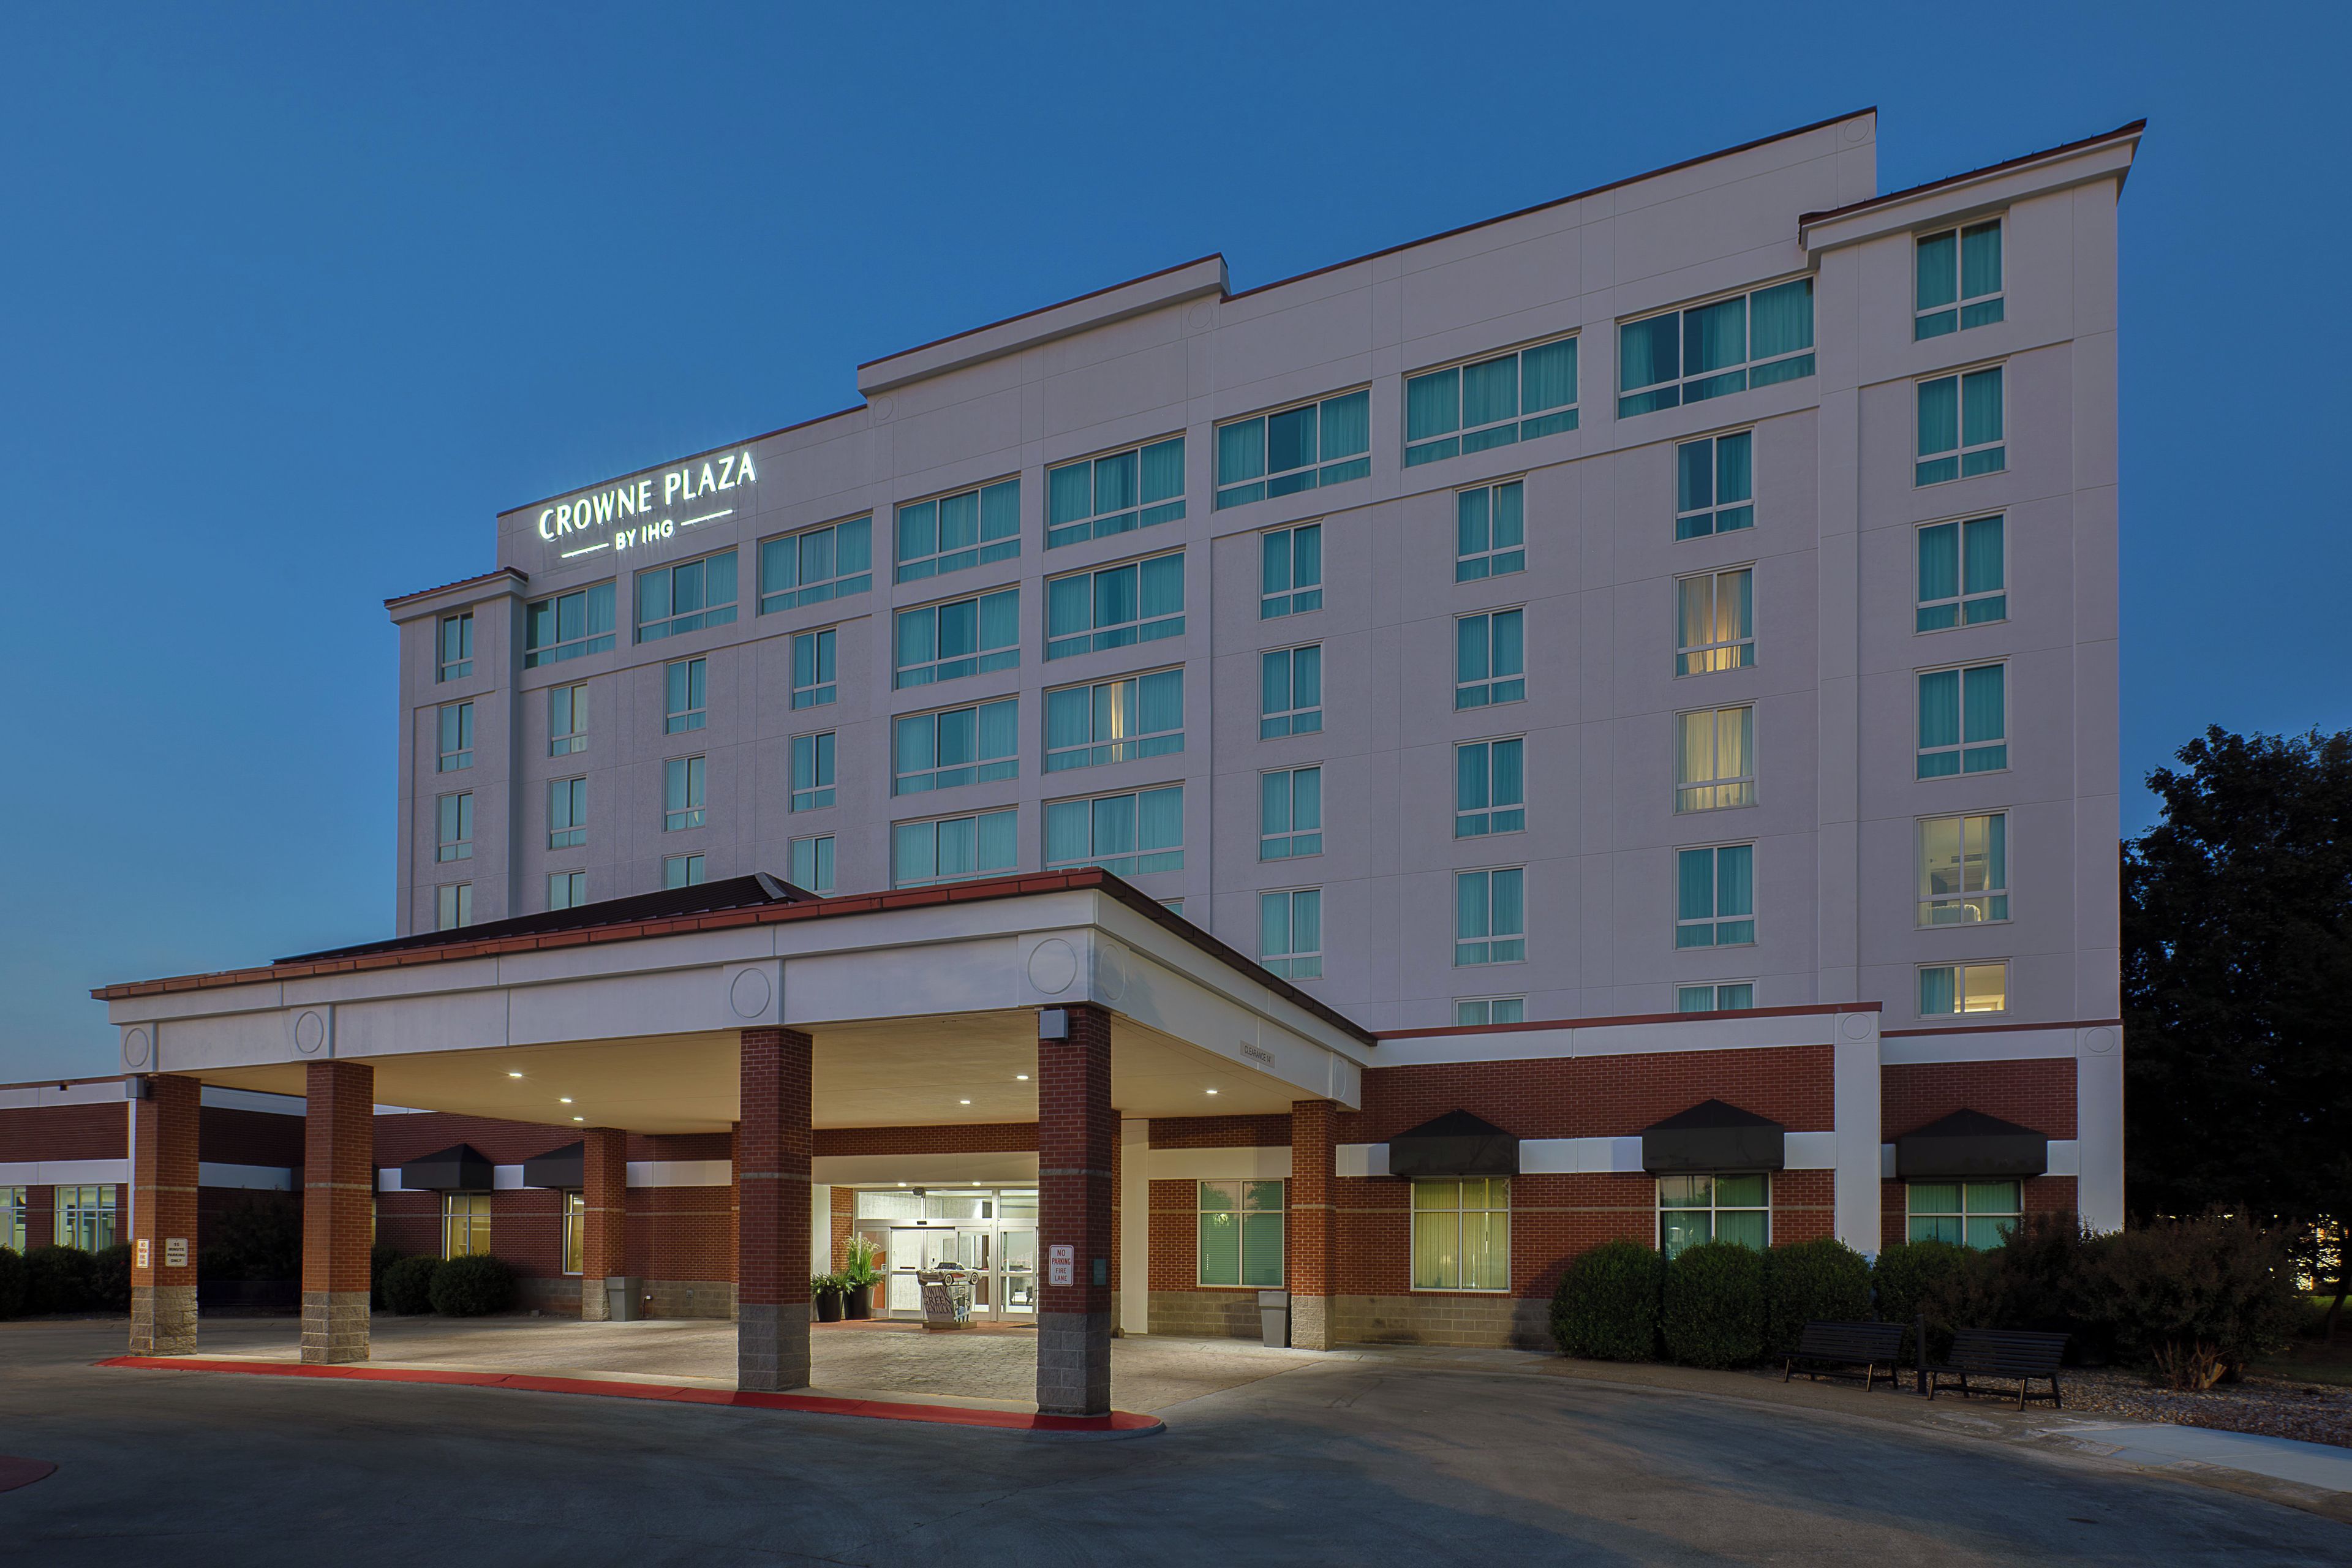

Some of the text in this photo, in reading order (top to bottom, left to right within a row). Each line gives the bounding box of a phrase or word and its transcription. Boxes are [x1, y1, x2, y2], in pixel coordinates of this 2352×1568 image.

[539, 451, 756, 540] CROWNE PLAZA
[616, 519, 674, 551] BY IHG
[1244, 1045, 1266, 1061] CLEARANCE
[923, 1296, 951, 1305] GREEN
